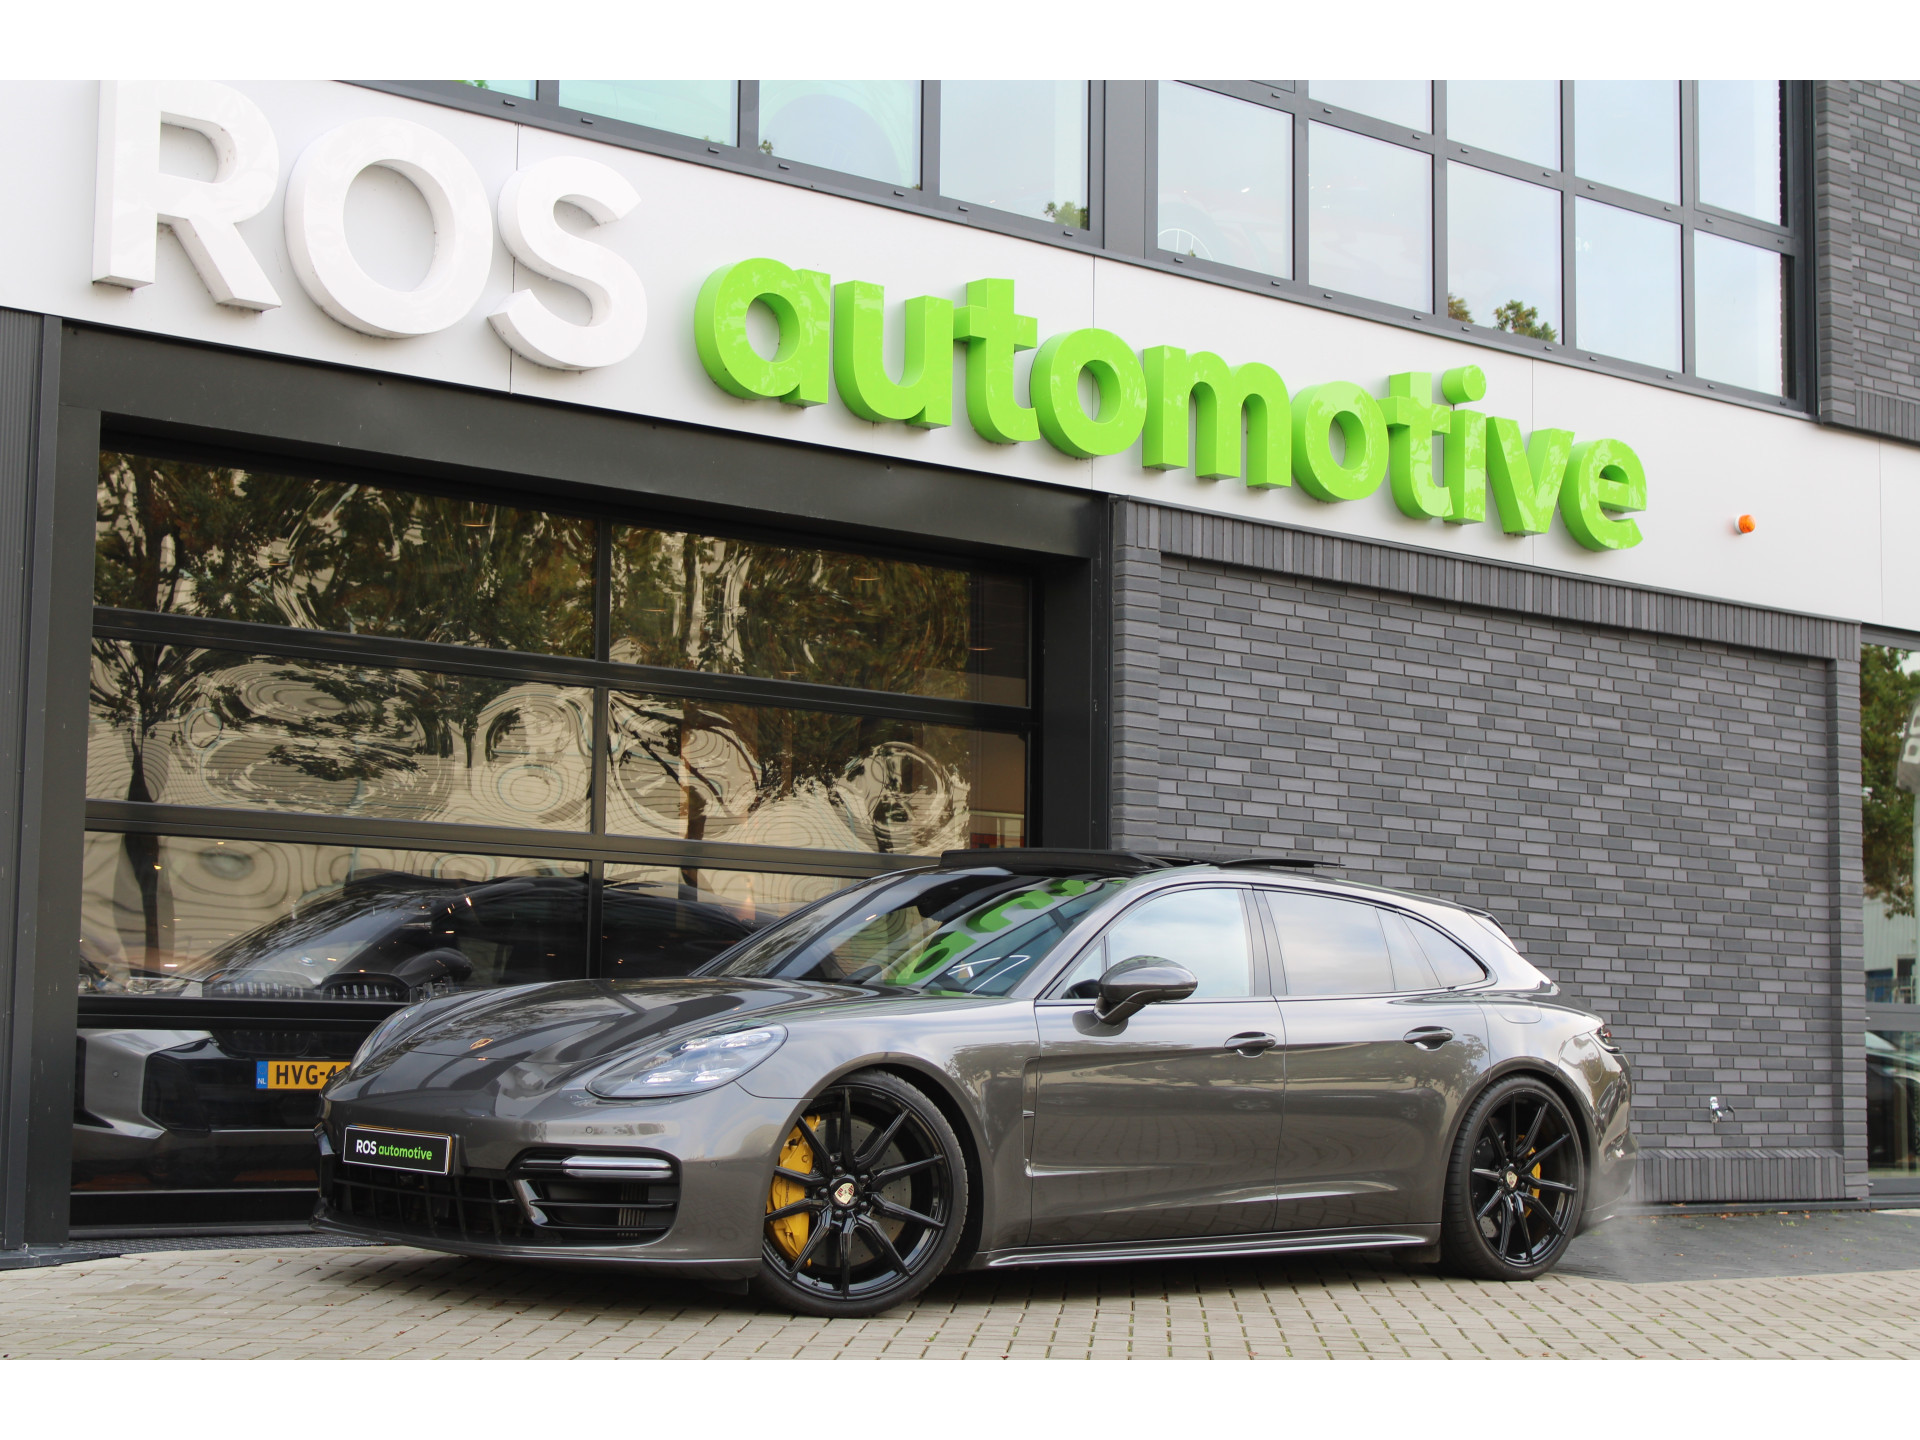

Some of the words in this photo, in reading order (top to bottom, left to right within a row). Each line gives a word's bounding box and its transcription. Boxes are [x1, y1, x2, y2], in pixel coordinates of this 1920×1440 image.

[92, 80, 648, 371] ROS
[694, 257, 1648, 551] automotive
[276, 1064, 346, 1085] HVG-4
[355, 1139, 377, 1155] ROS
[378, 1143, 433, 1161] automotive
